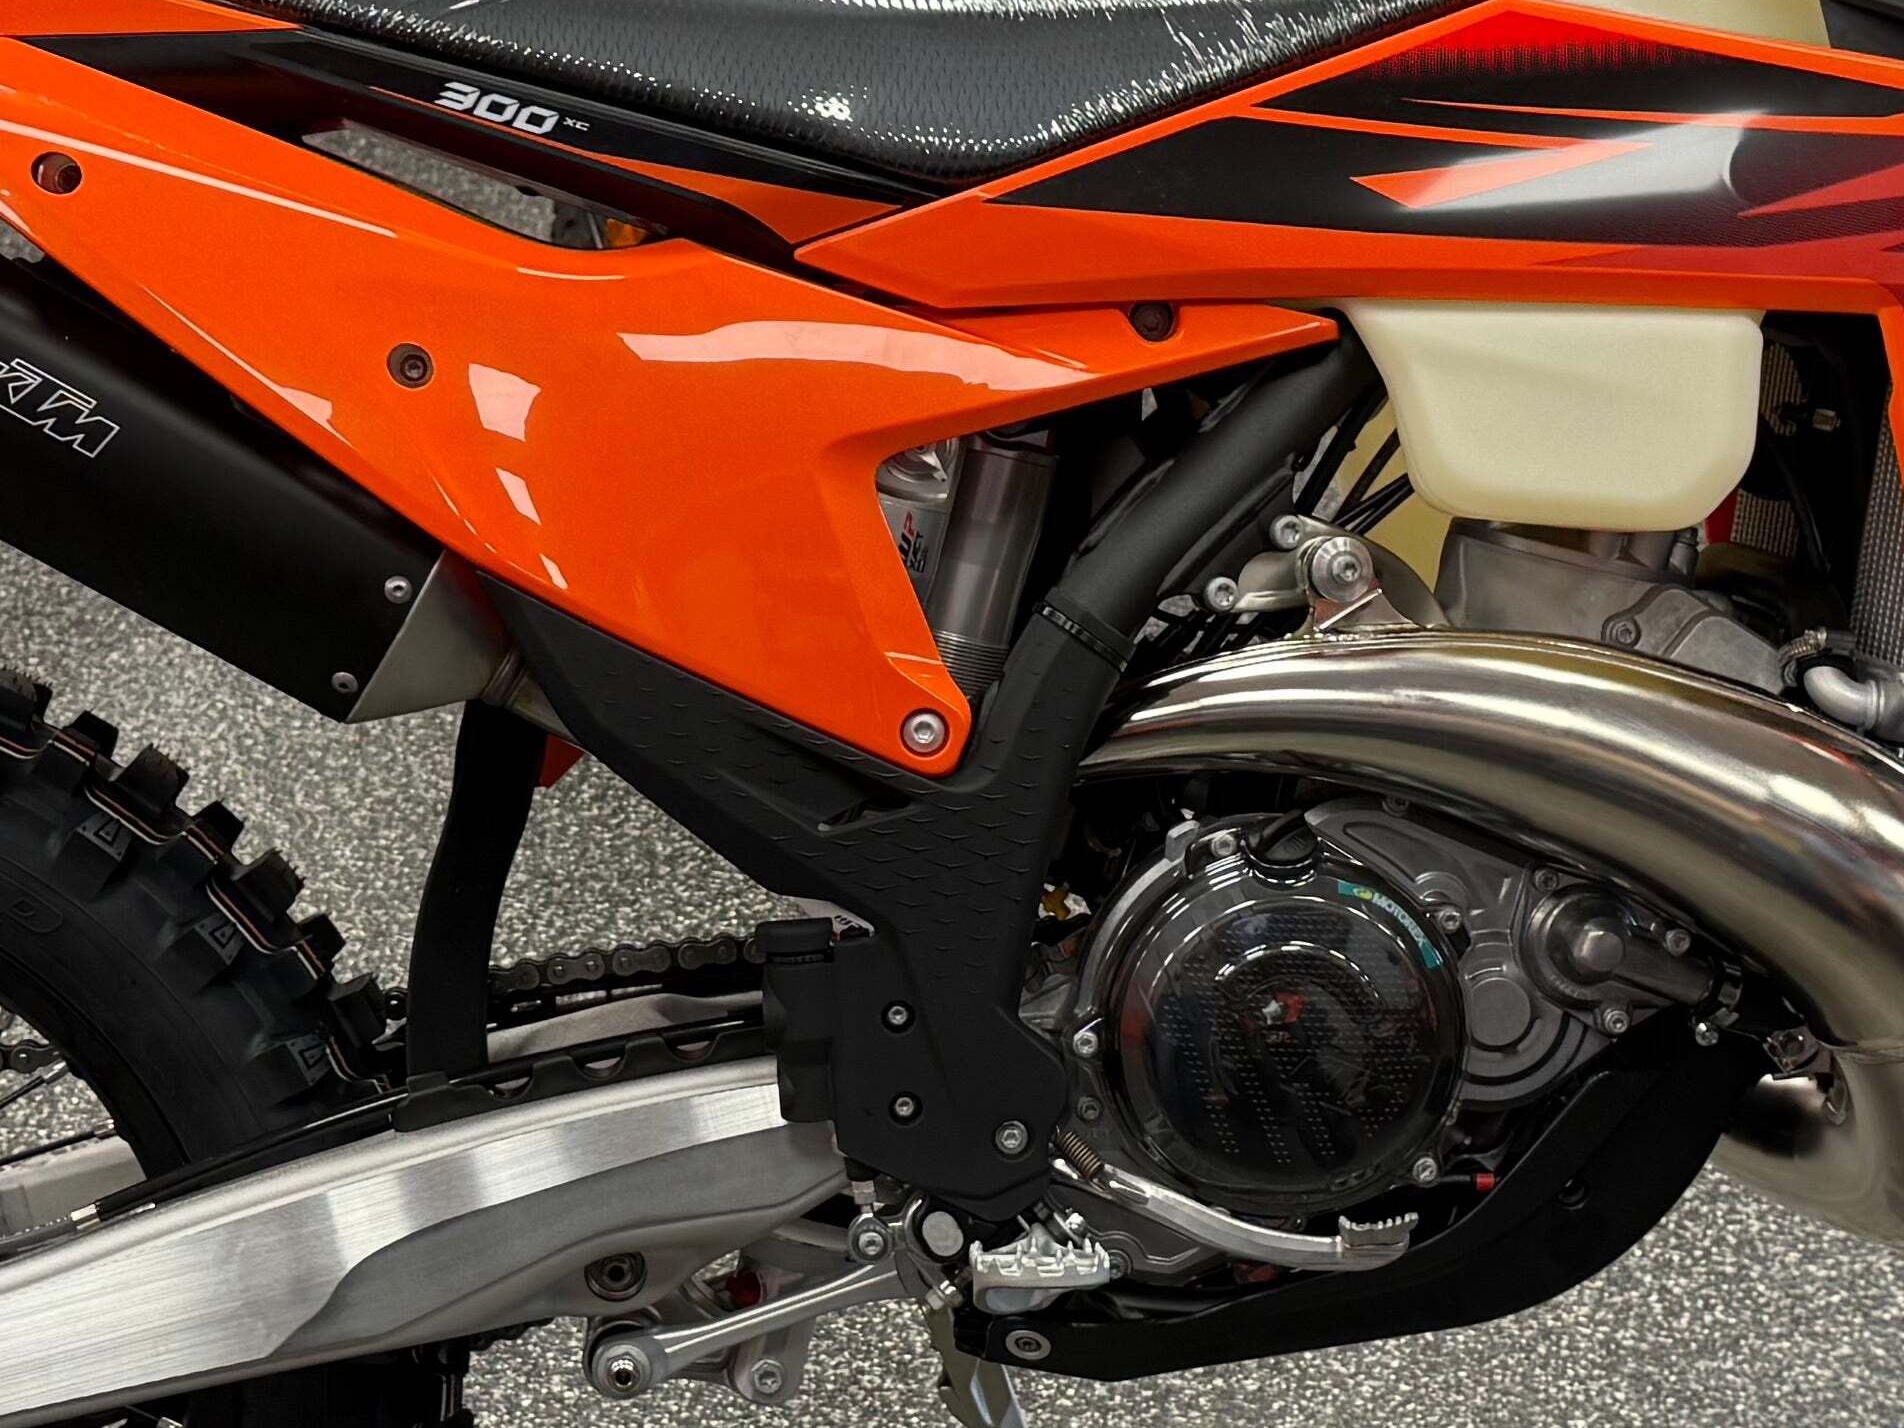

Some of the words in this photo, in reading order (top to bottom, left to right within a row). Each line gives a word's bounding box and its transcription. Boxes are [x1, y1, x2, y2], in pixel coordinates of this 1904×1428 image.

[435, 80, 560, 135] 300
[562, 116, 591, 132] XC
[1372, 892, 1427, 948] MOTOREX
